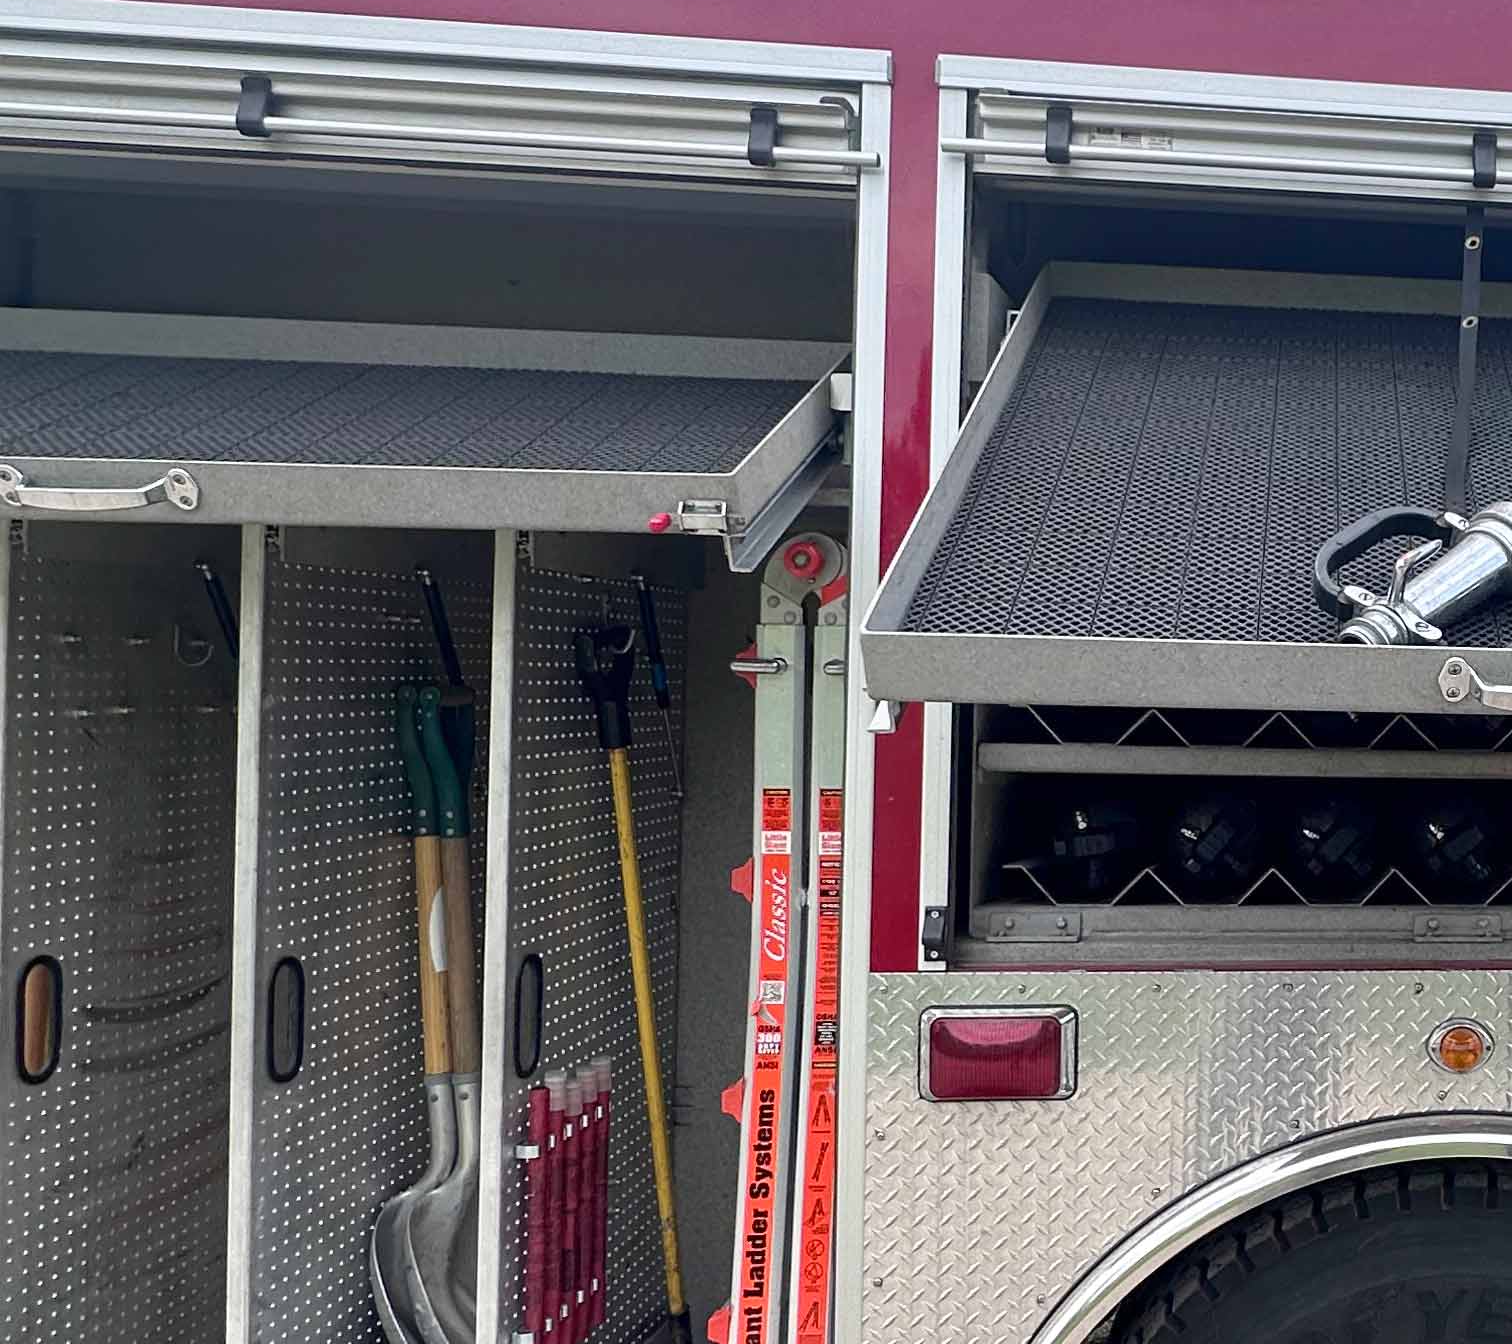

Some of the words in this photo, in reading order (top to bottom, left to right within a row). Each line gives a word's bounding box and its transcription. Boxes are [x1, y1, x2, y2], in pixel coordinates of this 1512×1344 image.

[763, 867, 788, 961] Classic
[749, 1088, 775, 1199] Systems
[744, 1208, 769, 1298] Ladder
